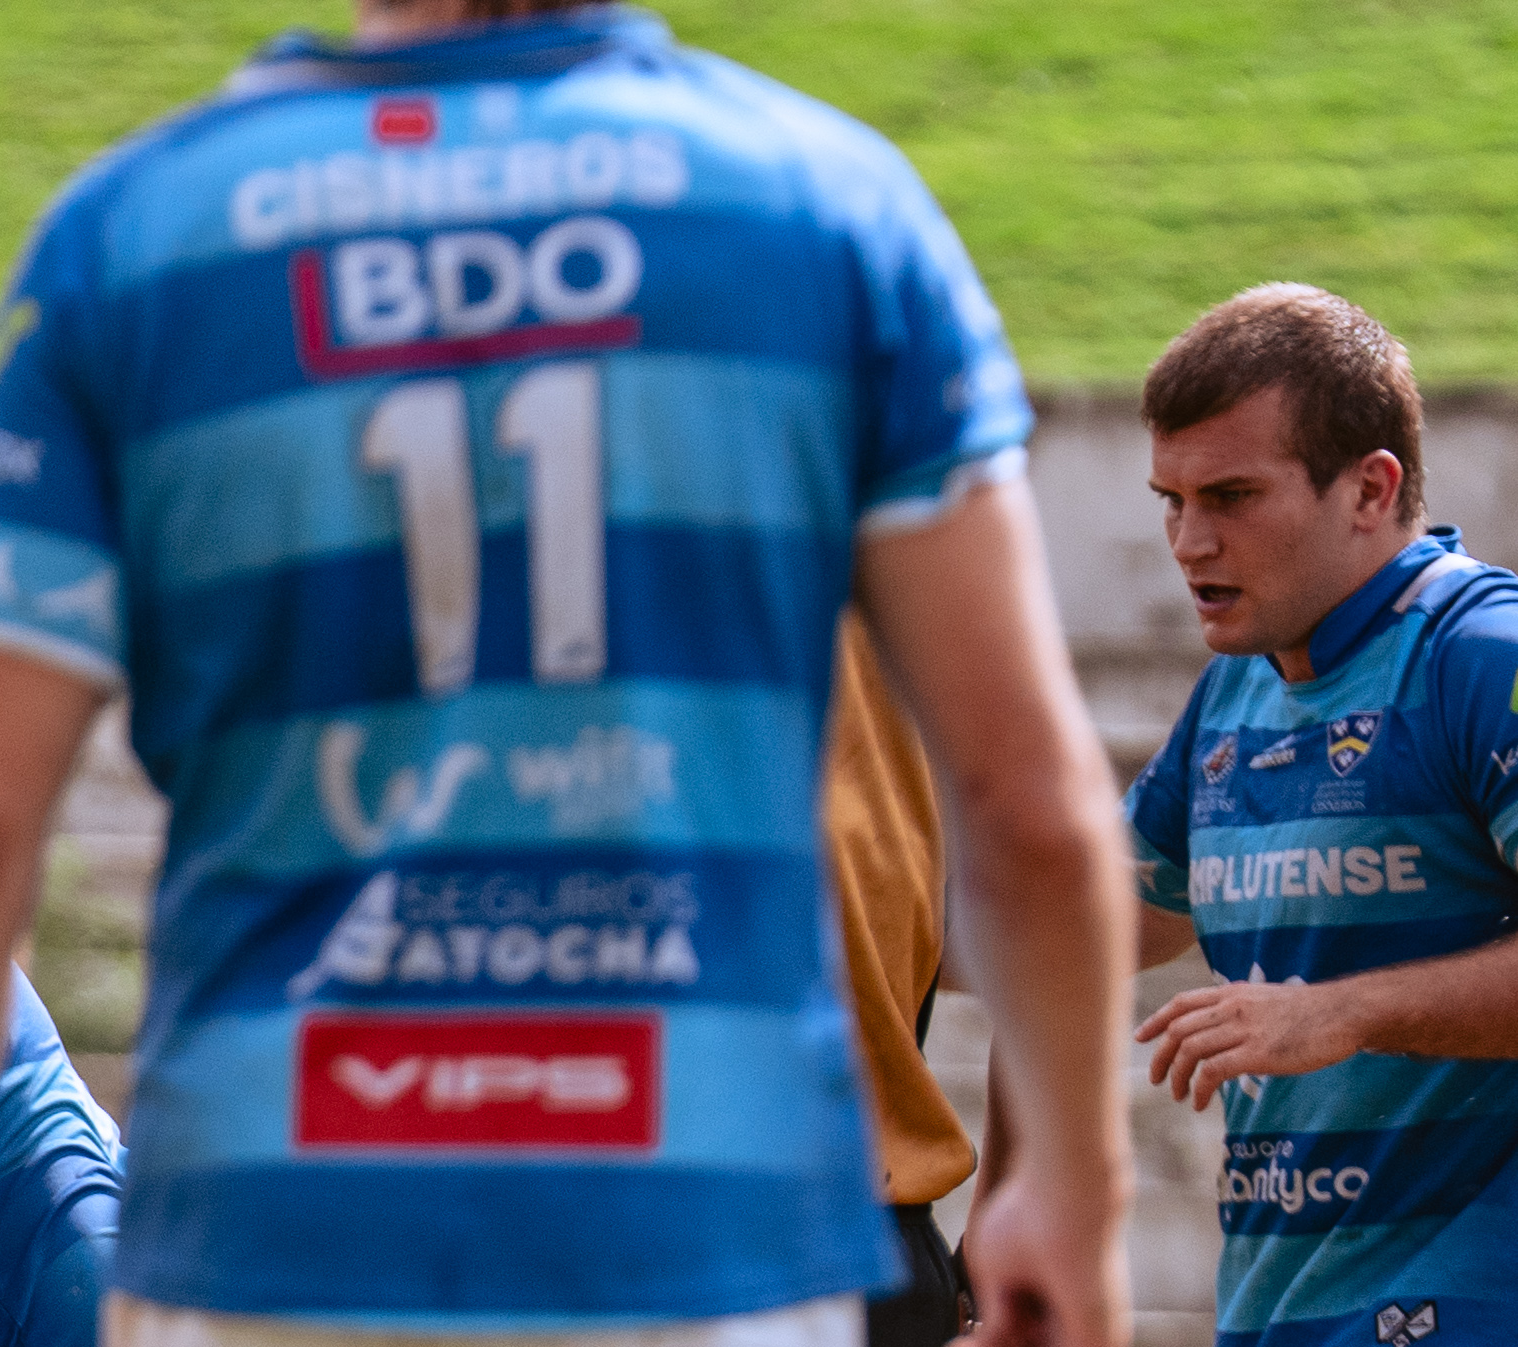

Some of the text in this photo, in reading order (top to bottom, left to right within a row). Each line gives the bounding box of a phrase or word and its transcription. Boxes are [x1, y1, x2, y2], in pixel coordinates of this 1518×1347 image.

[232, 128, 689, 252] CISNEROS
[331, 212, 645, 346] BDO
[363, 362, 607, 698] 11
[329, 1053, 637, 1114] VIPS
